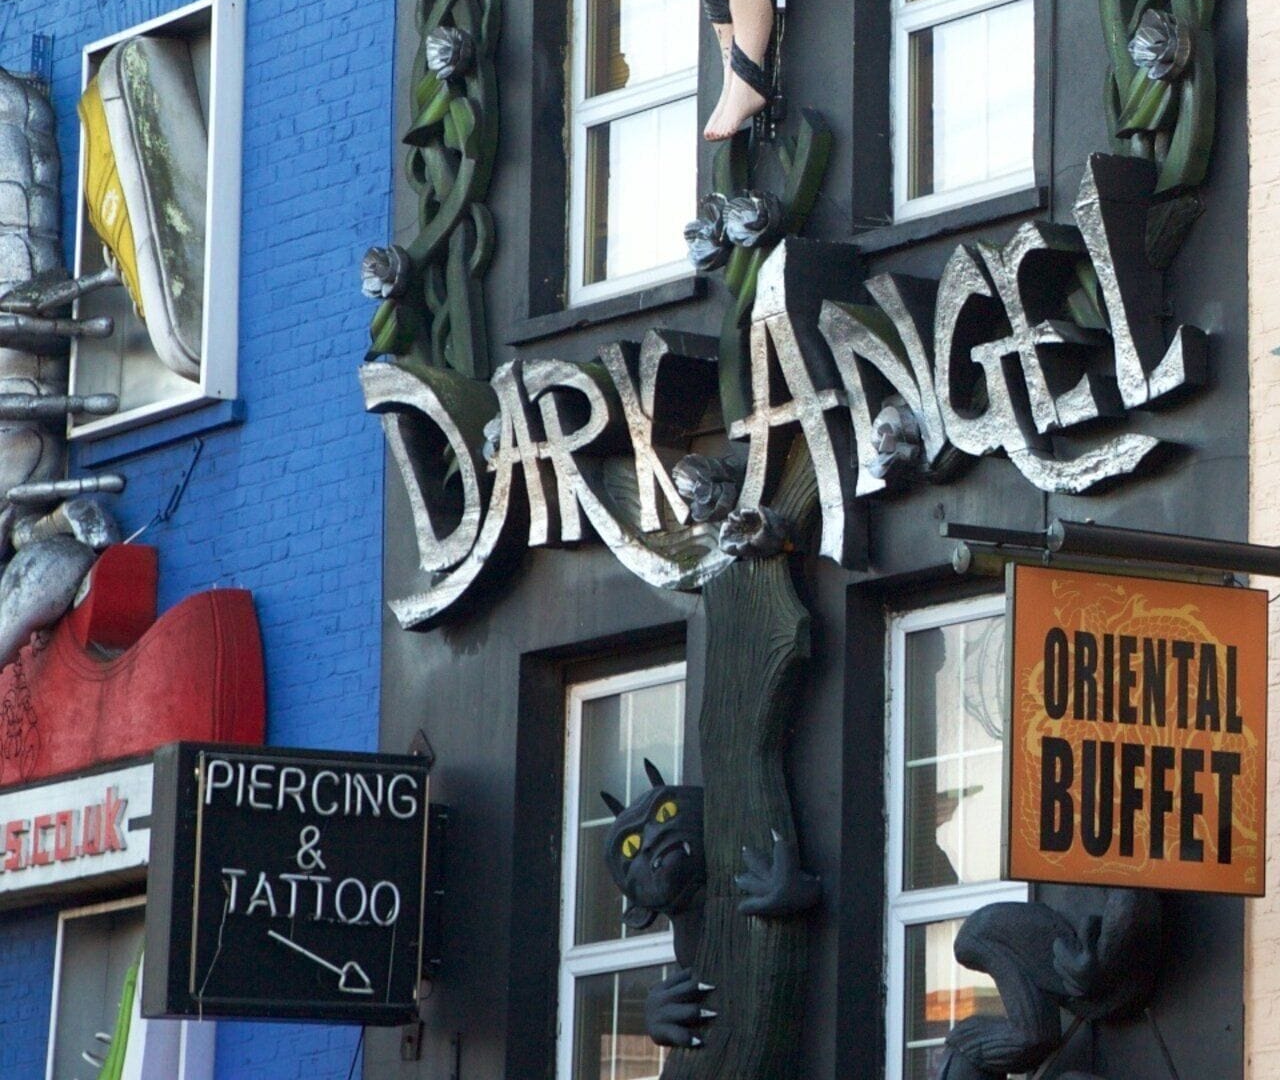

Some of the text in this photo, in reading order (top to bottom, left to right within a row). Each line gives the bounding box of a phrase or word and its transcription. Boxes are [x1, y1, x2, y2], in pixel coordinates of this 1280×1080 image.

[359, 152, 1190, 631] DARK ANGEL
[1043, 626, 1243, 734] ORIENTAL
[0, 785, 128, 873] s.co.uk
[204, 759, 418, 819] PIERCING
[1039, 735, 1242, 865] BUFFET
[296, 824, 327, 870] &
[221, 867, 401, 927] TATTOO
